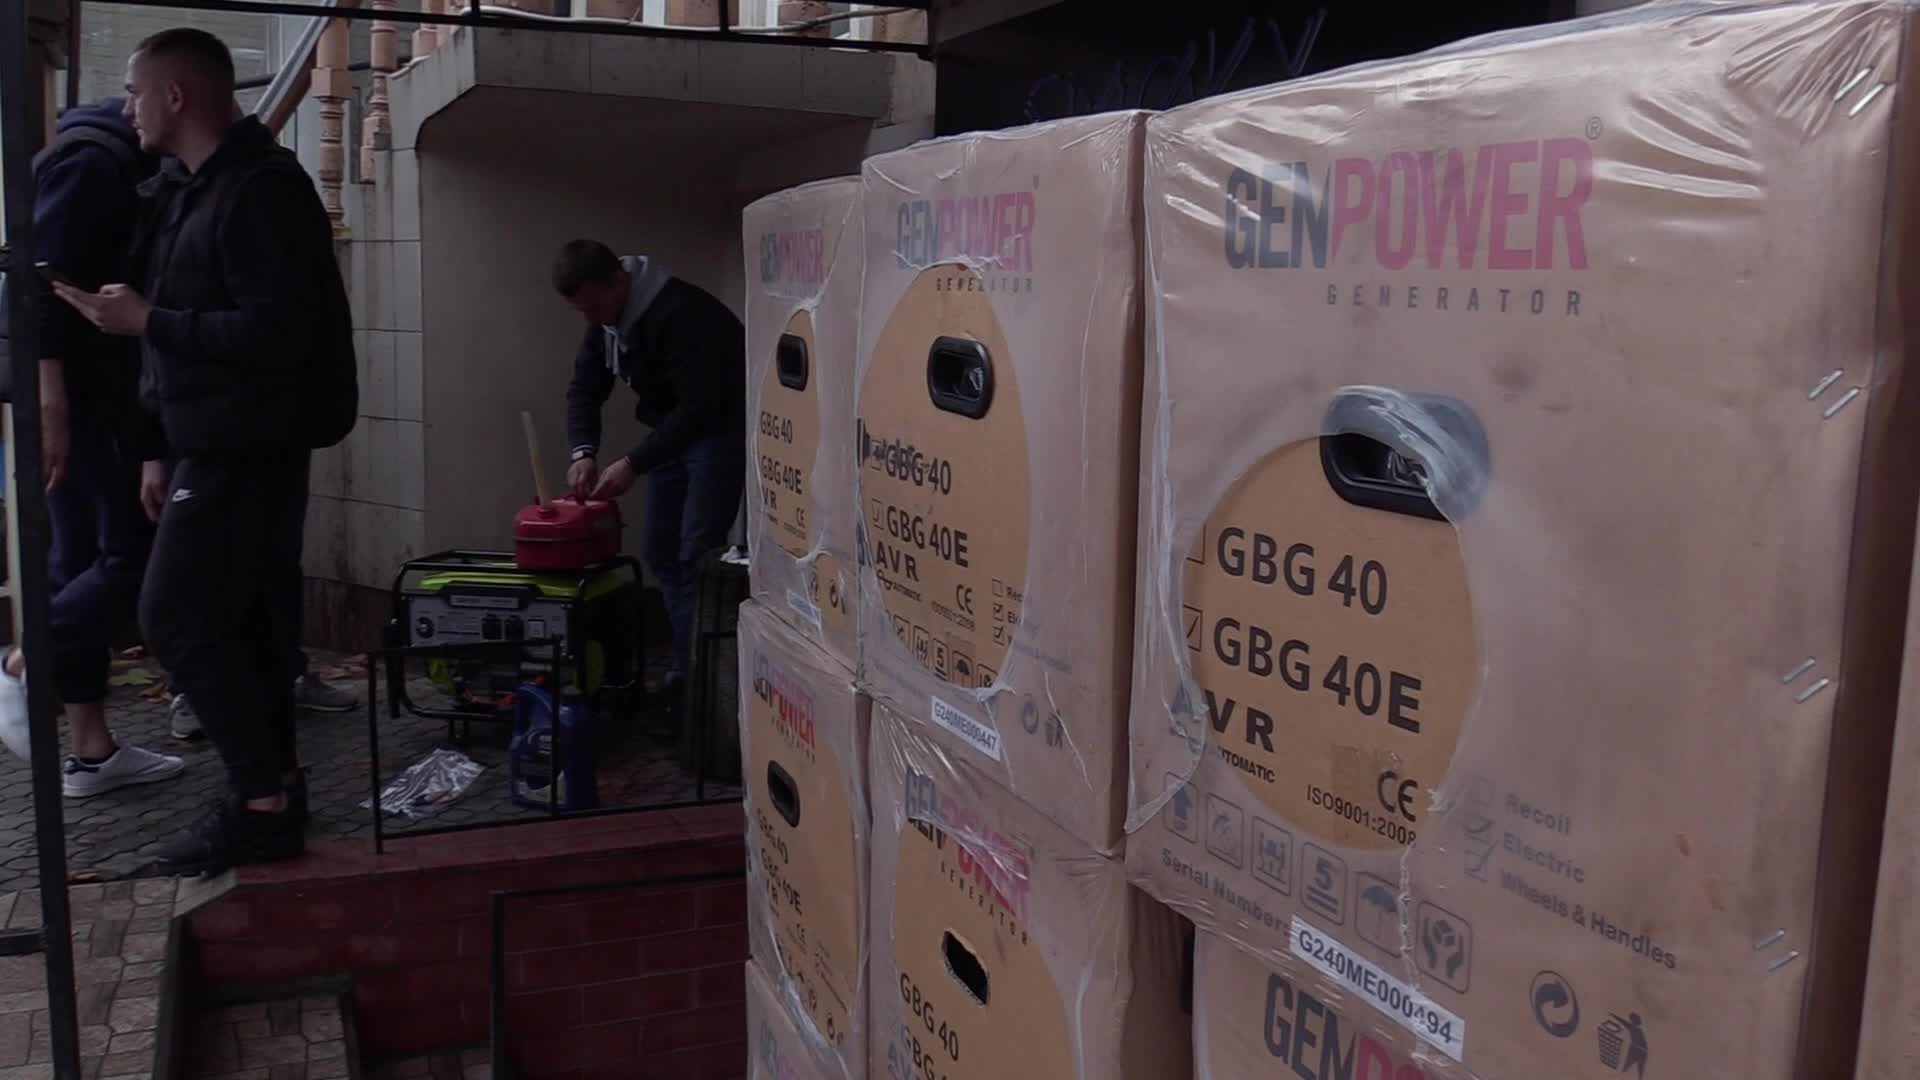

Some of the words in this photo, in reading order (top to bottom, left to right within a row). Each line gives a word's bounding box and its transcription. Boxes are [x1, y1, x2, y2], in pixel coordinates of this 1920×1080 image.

[1224, 136, 1594, 271] GENPOWER
[1327, 284, 1582, 316] GENERATOR
[760, 410, 780, 440] GBG
[781, 416, 793, 445] 40
[761, 455, 781, 486] GBG
[783, 464, 802, 495] 40E
[886, 444, 924, 486] GBG
[928, 458, 952, 496] 40
[887, 504, 926, 551] GBG
[929, 523, 969, 569] 40E
[1216, 526, 1316, 597] GBG
[1327, 554, 1388, 616] 40
[1213, 617, 1312, 693] GBG
[1322, 655, 1422, 733] 40E
[1504, 793, 1572, 836] Recoil
[1161, 847, 1209, 889] Serial
[1502, 831, 1586, 884] Electric
[1500, 868, 1569, 918] Wheels
[1571, 903, 1587, 928] &
[1590, 911, 1678, 970] Handles
[900, 971, 935, 1034] GBG
[938, 1019, 960, 1062] 40
